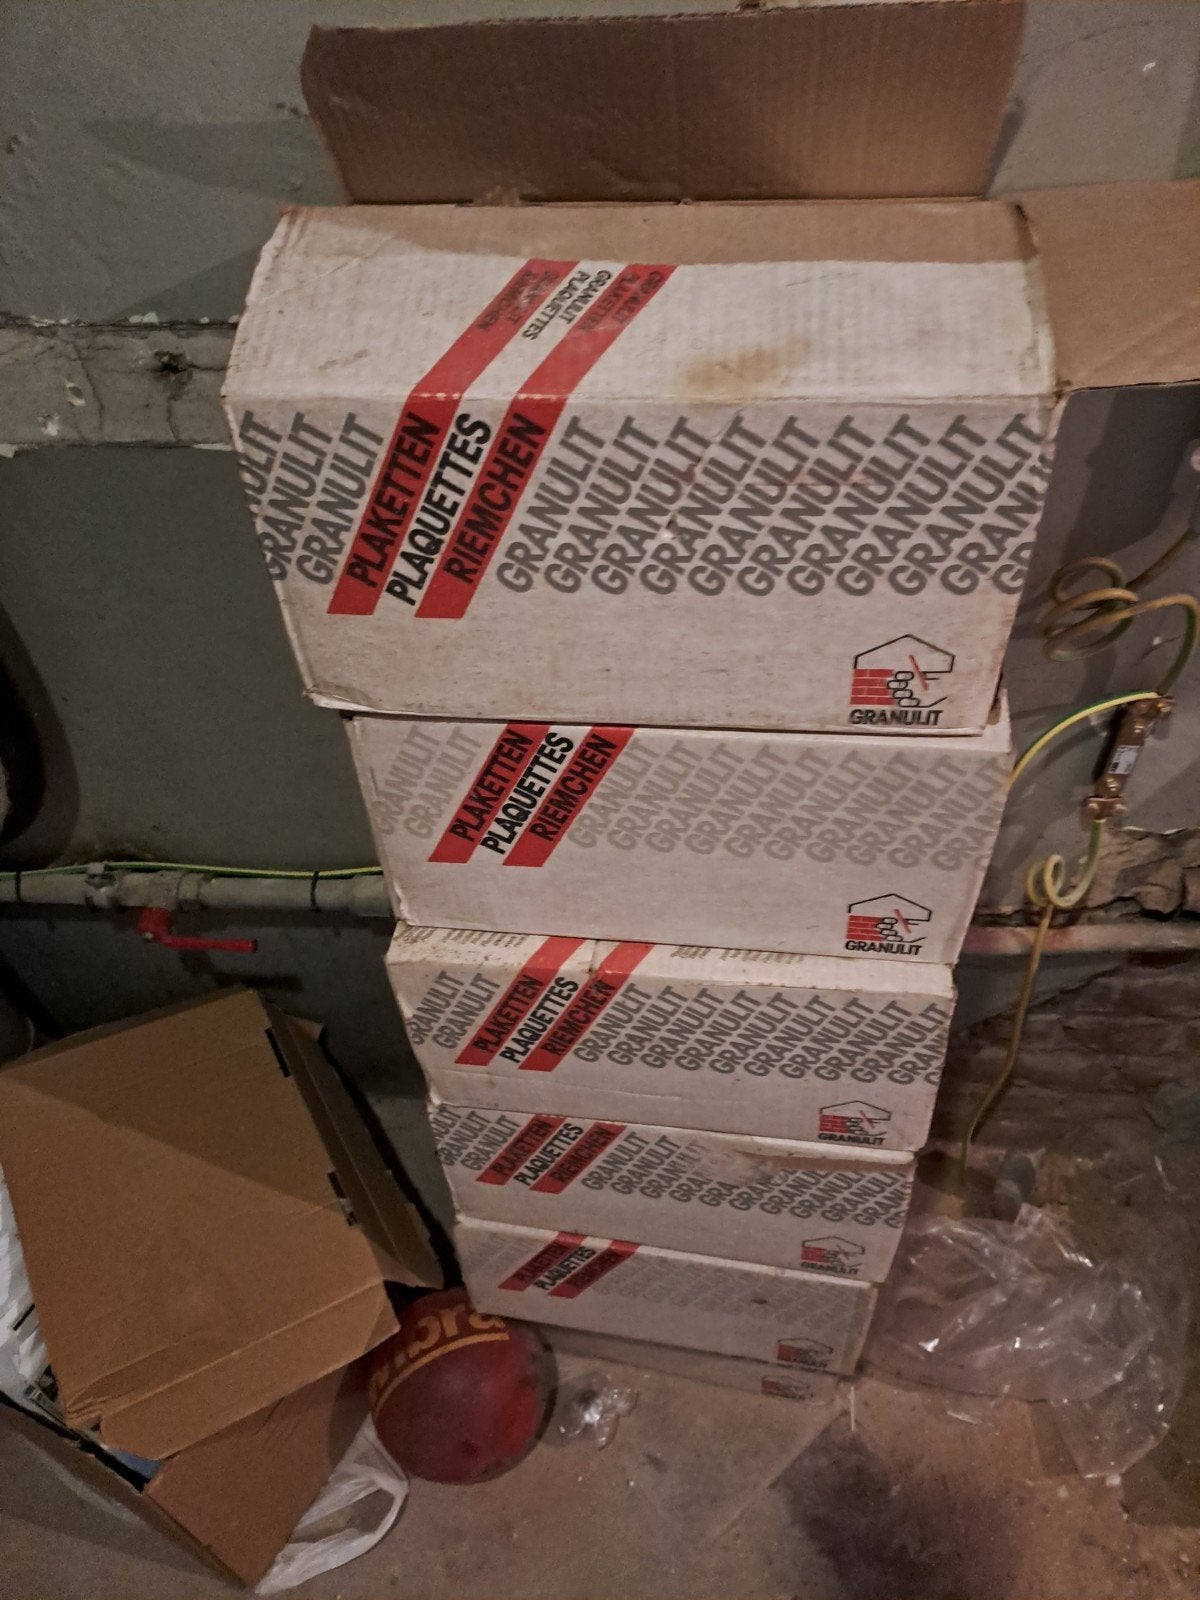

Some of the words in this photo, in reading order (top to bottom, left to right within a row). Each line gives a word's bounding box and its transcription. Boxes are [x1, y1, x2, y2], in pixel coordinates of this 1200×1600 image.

[522, 270, 591, 341] PLAQUETTES
[559, 269, 612, 325] GRANULIT
[296, 412, 384, 585] GRANULIT
[346, 412, 441, 588] PLAKETTEN
[385, 413, 491, 606] PLAQUETTES
[443, 412, 547, 585] RIEMCHEN
[496, 415, 606, 593] GRANULIT
[544, 415, 659, 594] GRANULIT
[591, 415, 712, 595] GRANULIT
[640, 415, 767, 595] GRANULIT
[688, 415, 820, 597] GRANULIT
[736, 414, 876, 597] GRANULIT
[786, 413, 931, 597] GRANULIT
[836, 413, 988, 597] GRANULIT
[888, 412, 1046, 597] GRANULIT
[849, 709, 944, 725] GRANULIT
[402, 726, 483, 840] GRANULIT
[450, 728, 535, 842] PLAKETTEN
[479, 731, 575, 855] PLAQUETTES
[528, 732, 618, 842] RIEMCHEN
[566, 737, 660, 849] GRANULIT
[605, 739, 704, 851] GRANULIT
[643, 741, 747, 854] GRANULIT
[684, 743, 790, 855] GRANULIT
[722, 747, 833, 858] GRANULIT
[763, 749, 879, 861] GRANULIT
[804, 751, 925, 864] GRANULIT
[845, 753, 968, 867] GRANULIT
[845, 940, 923, 956] GRANULIT
[432, 972, 501, 1050] GRANULIT
[472, 974, 545, 1054] PLAKETTEN
[499, 976, 580, 1064] PLAQUETTES
[540, 978, 617, 1056] RIEMCHEN
[573, 982, 652, 1063] GRANULIT
[606, 985, 690, 1066] GRANULIT
[640, 987, 725, 1069] GRANULIT
[674, 989, 762, 1071] GRANULIT
[709, 992, 798, 1074] GRANULIT
[743, 994, 837, 1077] GRANULIT
[779, 997, 875, 1079] GRANULIT
[814, 1000, 913, 1082] GRANULIT
[850, 1002, 951, 1084] GRANULIT
[460, 1115, 522, 1171] GRANULIT
[513, 1122, 584, 1186] PLAQUETTES
[581, 1131, 650, 1191] GRANULIT
[610, 1134, 682, 1195] GRANULIT
[759, 1169, 834, 1215] GRANUL
[818, 1132, 886, 1146] GRANULIT
[533, 1245, 597, 1291] PLAQUETTES
